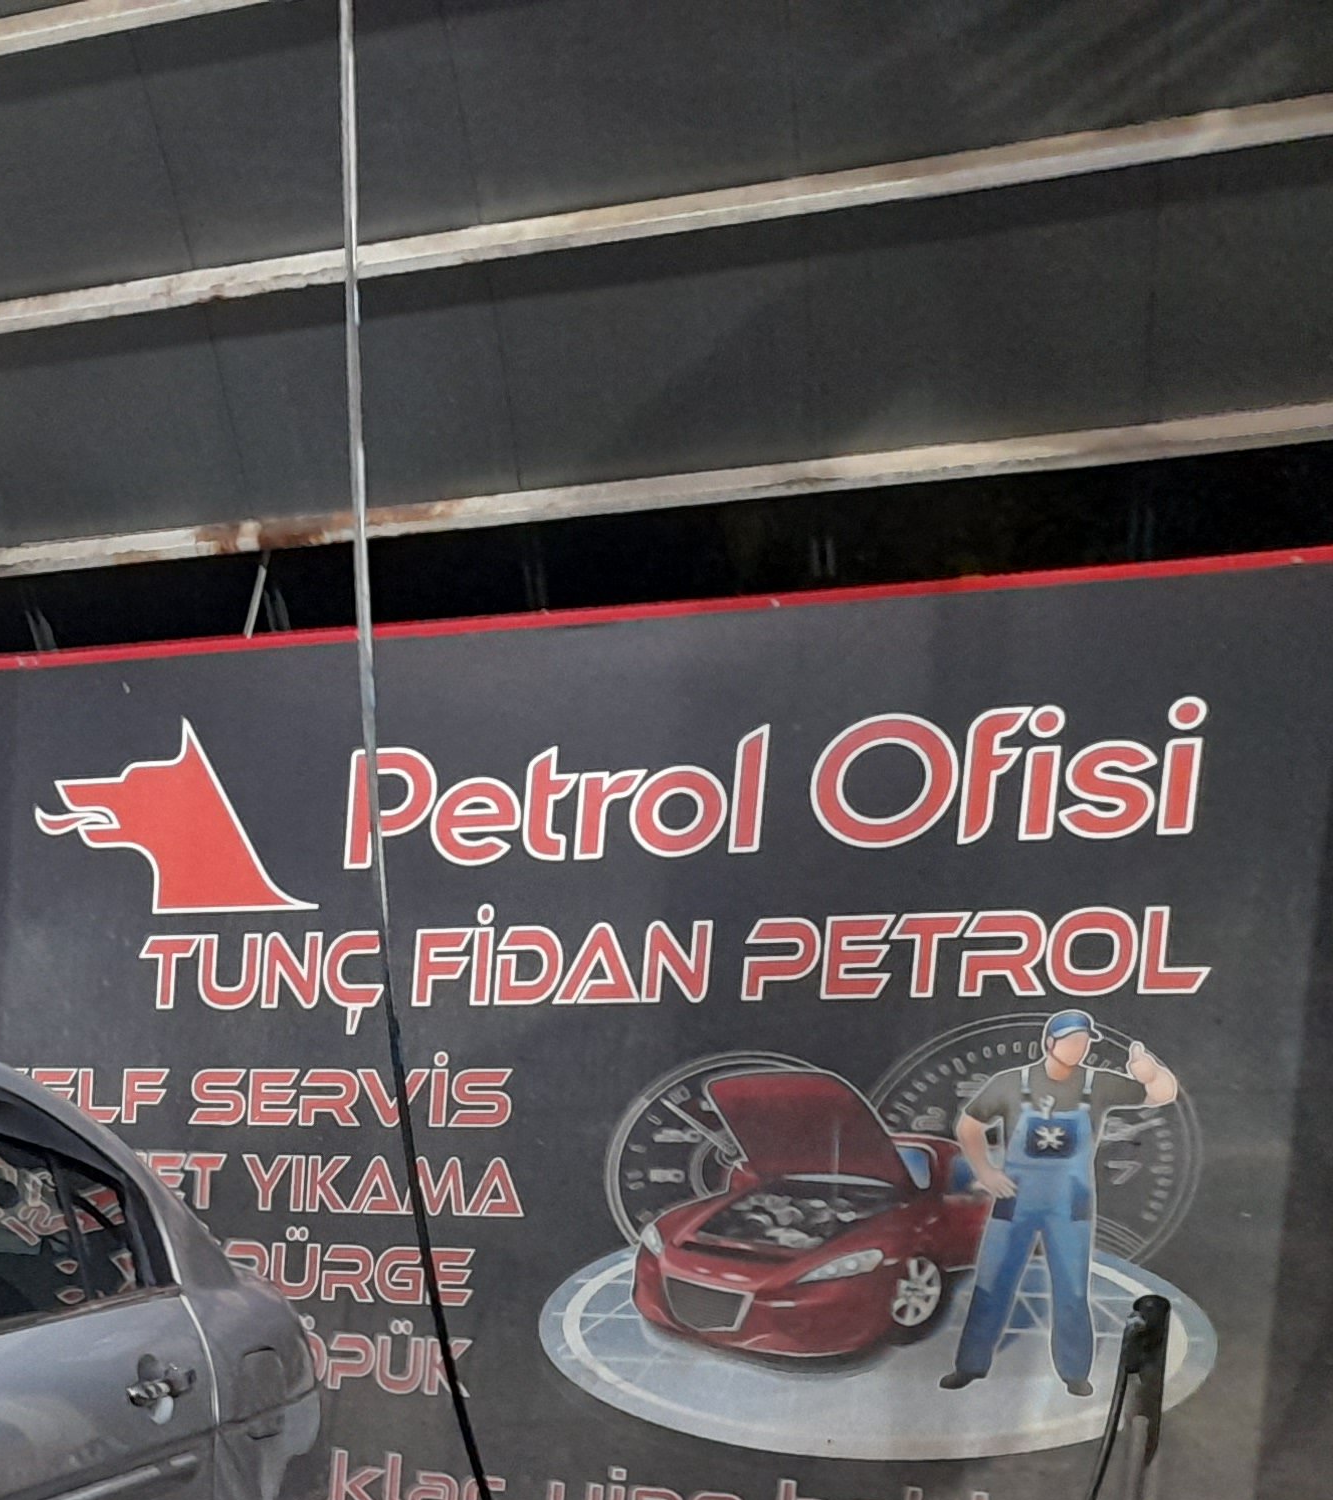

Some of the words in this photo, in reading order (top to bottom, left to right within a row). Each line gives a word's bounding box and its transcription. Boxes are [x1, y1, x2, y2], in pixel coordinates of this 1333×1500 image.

[342, 721, 770, 870] Petrol
[810, 696, 1209, 849] Ofisi
[139, 930, 384, 1035] TUNÇ
[410, 903, 714, 1007] FİDAN
[739, 906, 1211, 999] PETROL
[14, 1067, 171, 1125] ELF
[187, 1051, 513, 1128] SERVİS
[136, 1151, 228, 1210] ET
[242, 1153, 524, 1218] YIKAMA
